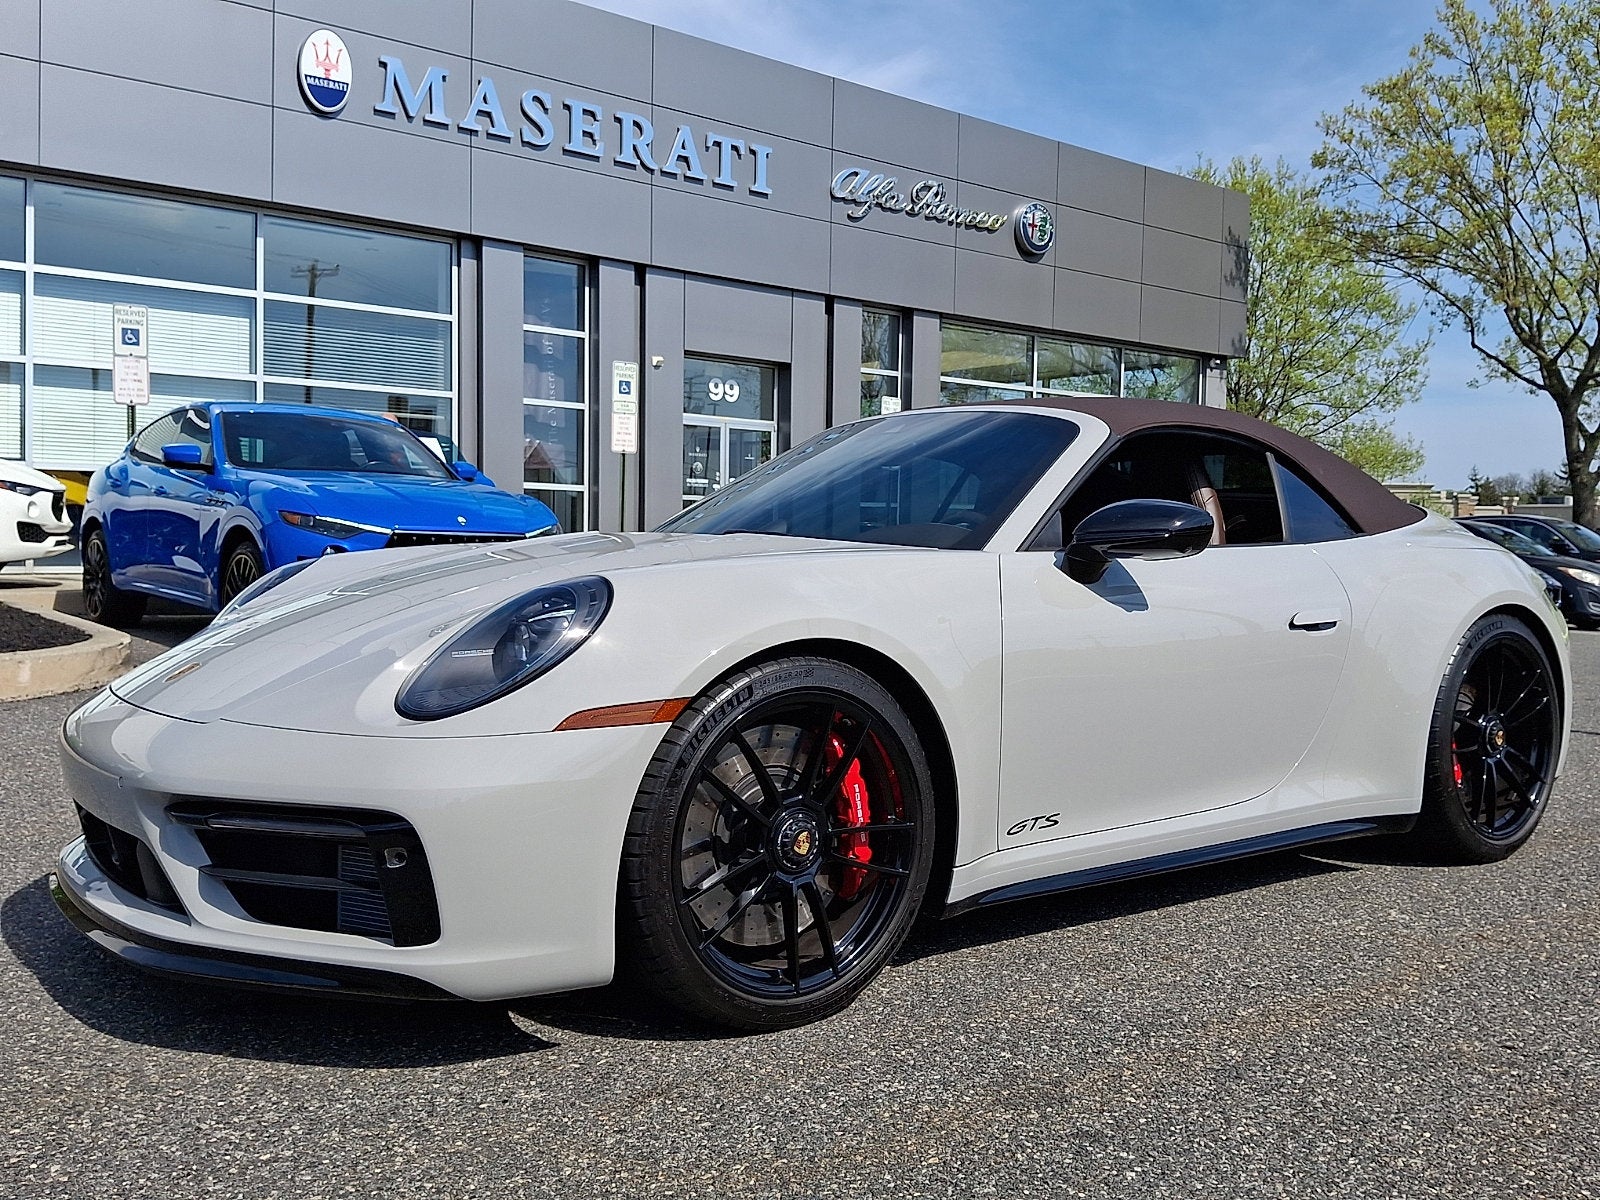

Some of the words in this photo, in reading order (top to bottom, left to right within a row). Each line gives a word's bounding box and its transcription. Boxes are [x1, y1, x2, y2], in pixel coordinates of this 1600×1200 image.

[306, 76, 348, 92] MASERATI
[373, 55, 773, 196] MASERATI
[831, 167, 905, 219] Alfa
[906, 180, 1008, 231] Romeo
[542, 339, 554, 355] of
[708, 378, 740, 403] 99
[681, 687, 750, 764] MICHELIN
[853, 783, 866, 843] PORSCE
[1006, 812, 1061, 836] GTS
